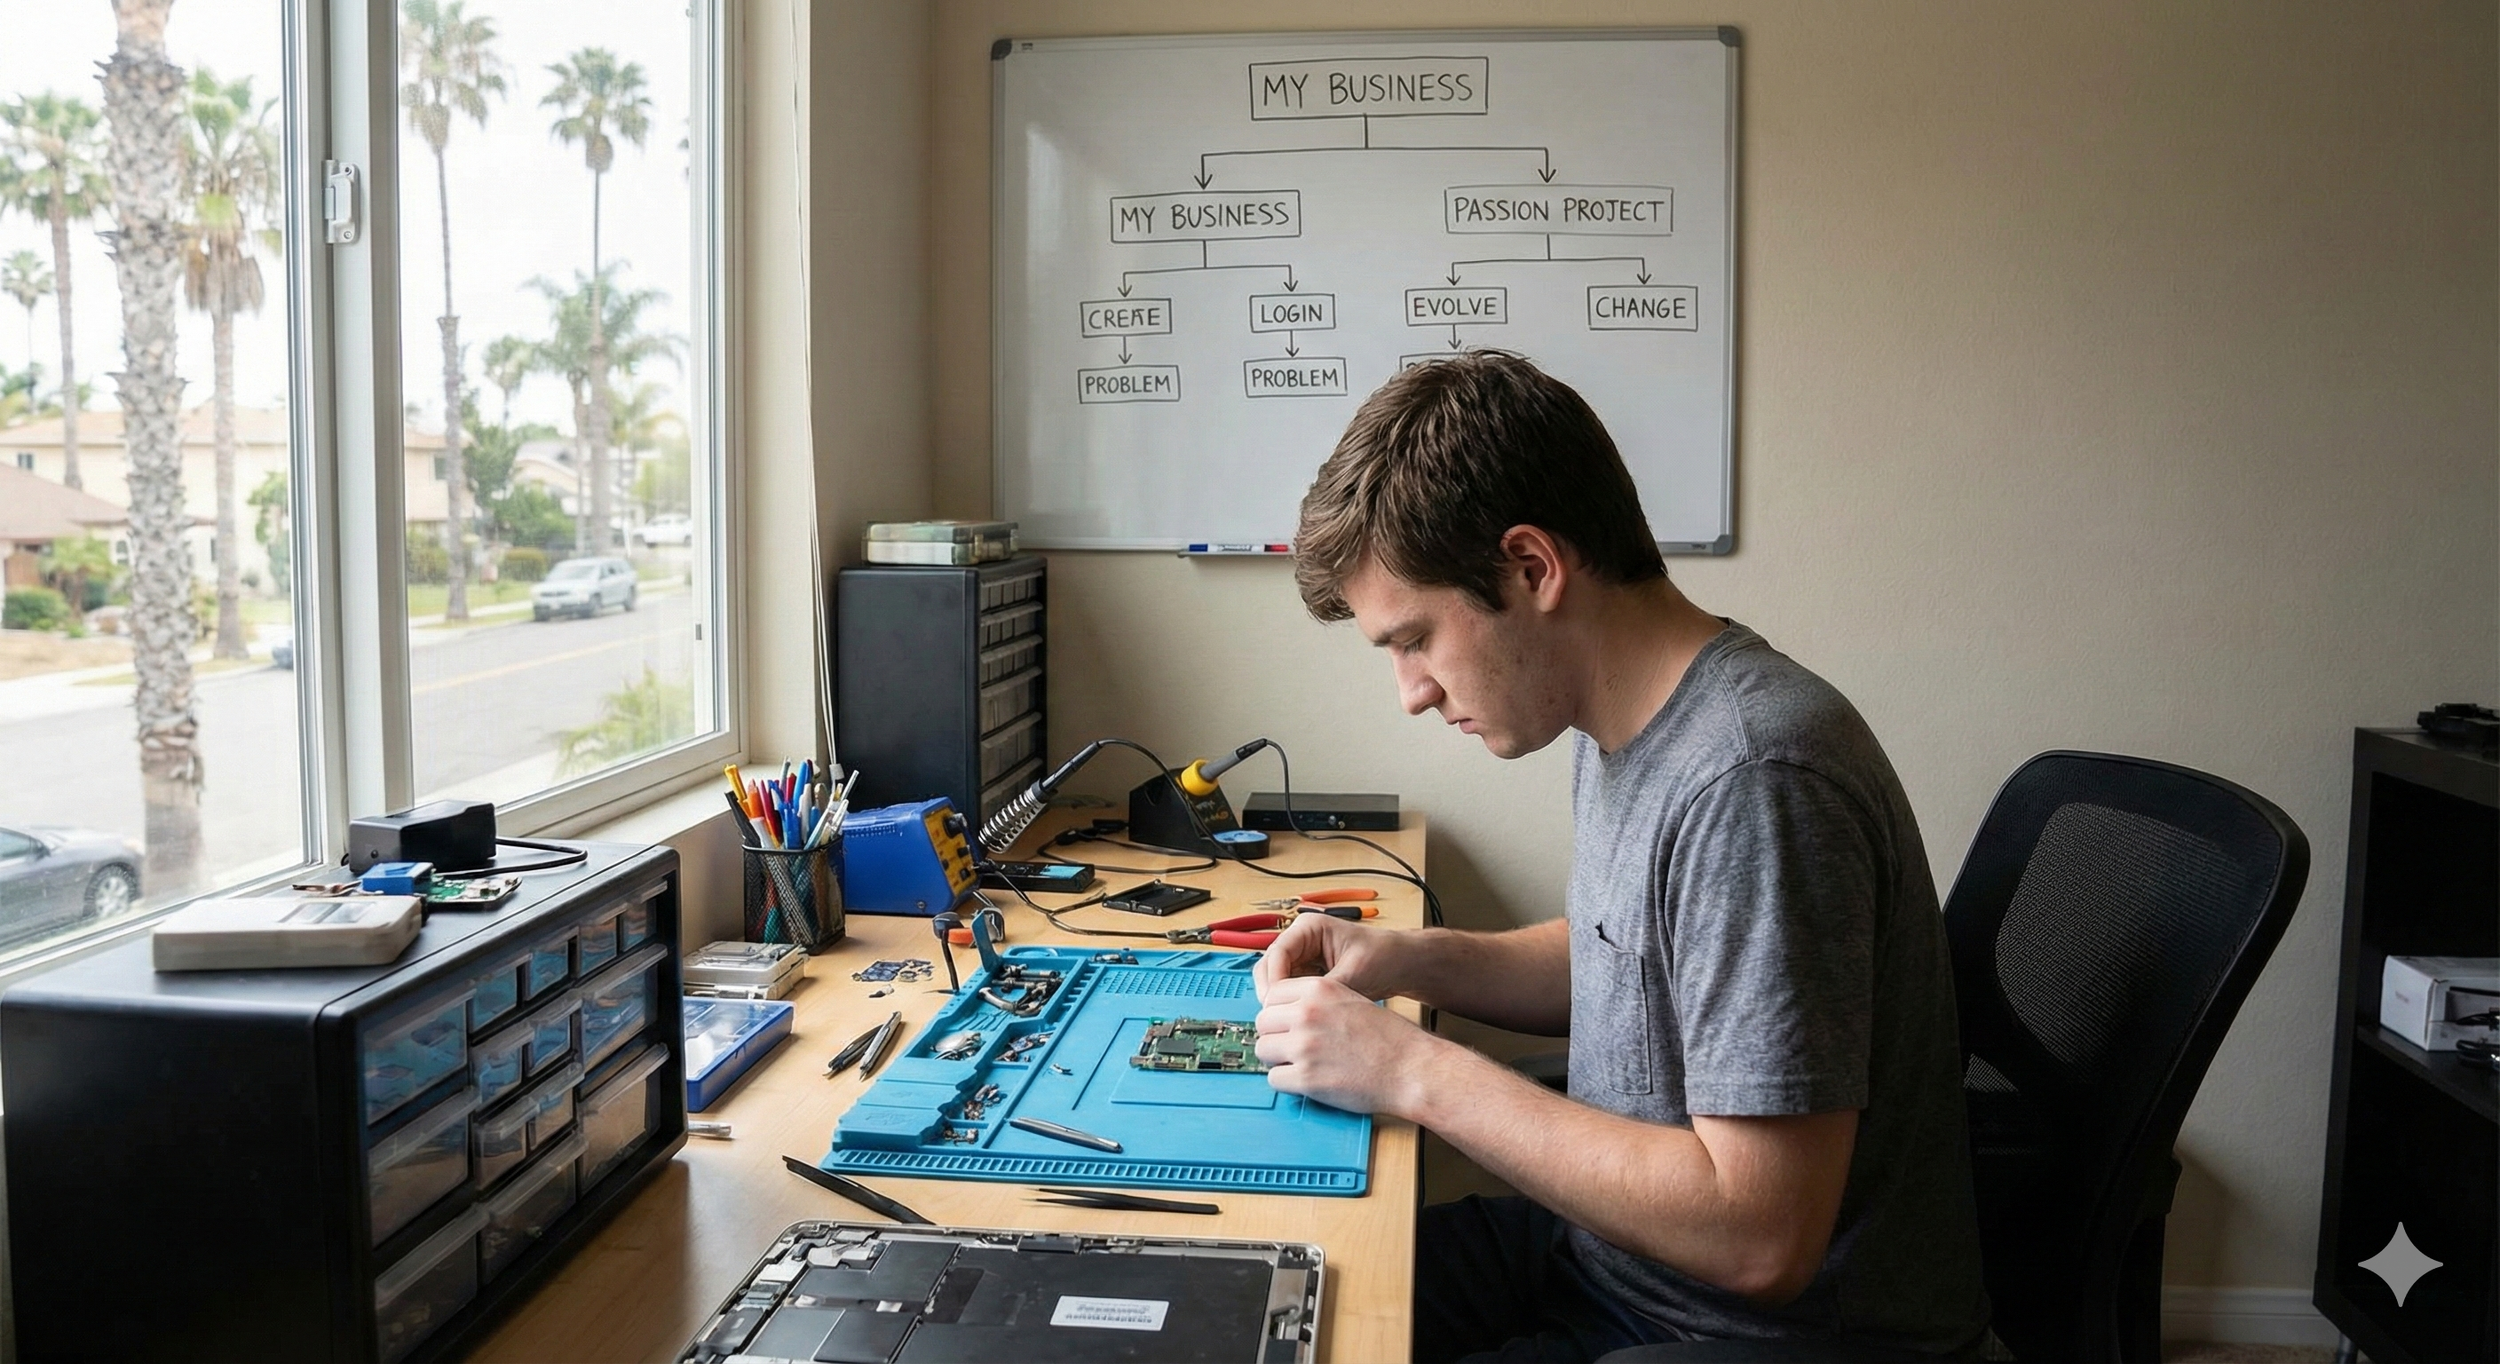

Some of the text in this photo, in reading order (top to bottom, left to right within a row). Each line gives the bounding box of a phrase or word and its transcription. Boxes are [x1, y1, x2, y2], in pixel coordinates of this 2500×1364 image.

[1263, 72, 1474, 110] MY BUSINESS
[1120, 201, 1290, 235] MY BUSINESS
[1453, 196, 1665, 223] PASSION PROJECT
[1260, 303, 1323, 324] LOGIN
[1413, 296, 1498, 318] EVOLVE
[1595, 295, 1687, 319] CHANGE
[1084, 374, 1172, 395] PROBLEM
[1251, 367, 1339, 388] PROBLEM
